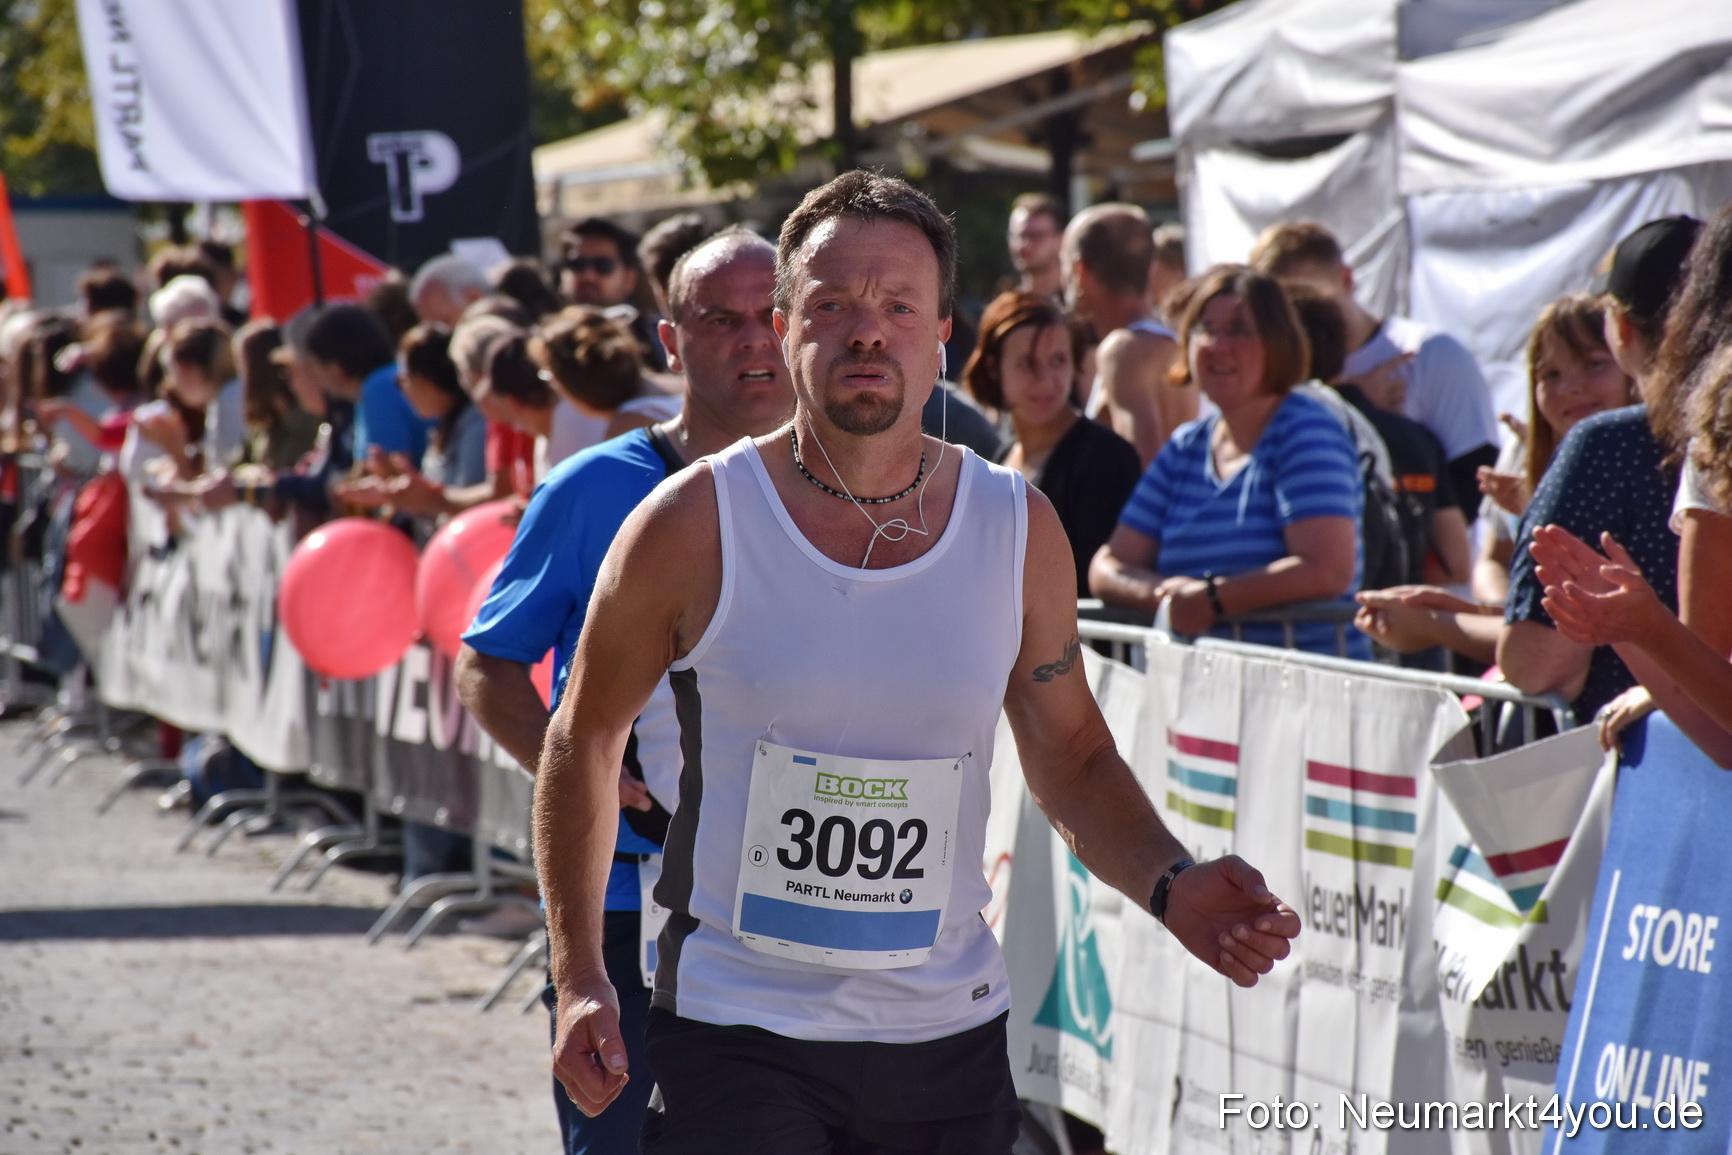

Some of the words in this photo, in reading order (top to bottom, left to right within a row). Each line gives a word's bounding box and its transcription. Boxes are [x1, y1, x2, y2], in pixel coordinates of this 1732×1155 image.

[815, 772, 909, 800] BOCK
[813, 794, 843, 805] inspired
[844, 799, 855, 808] by
[878, 801, 908, 809] concepts
[754, 850, 762, 862] D
[776, 808, 928, 880] 3092
[786, 880, 830, 899] PARTL
[834, 889, 895, 903] Neumarkt
[1621, 903, 1719, 974] STORE
[1595, 1042, 1710, 1114] ONLINE
